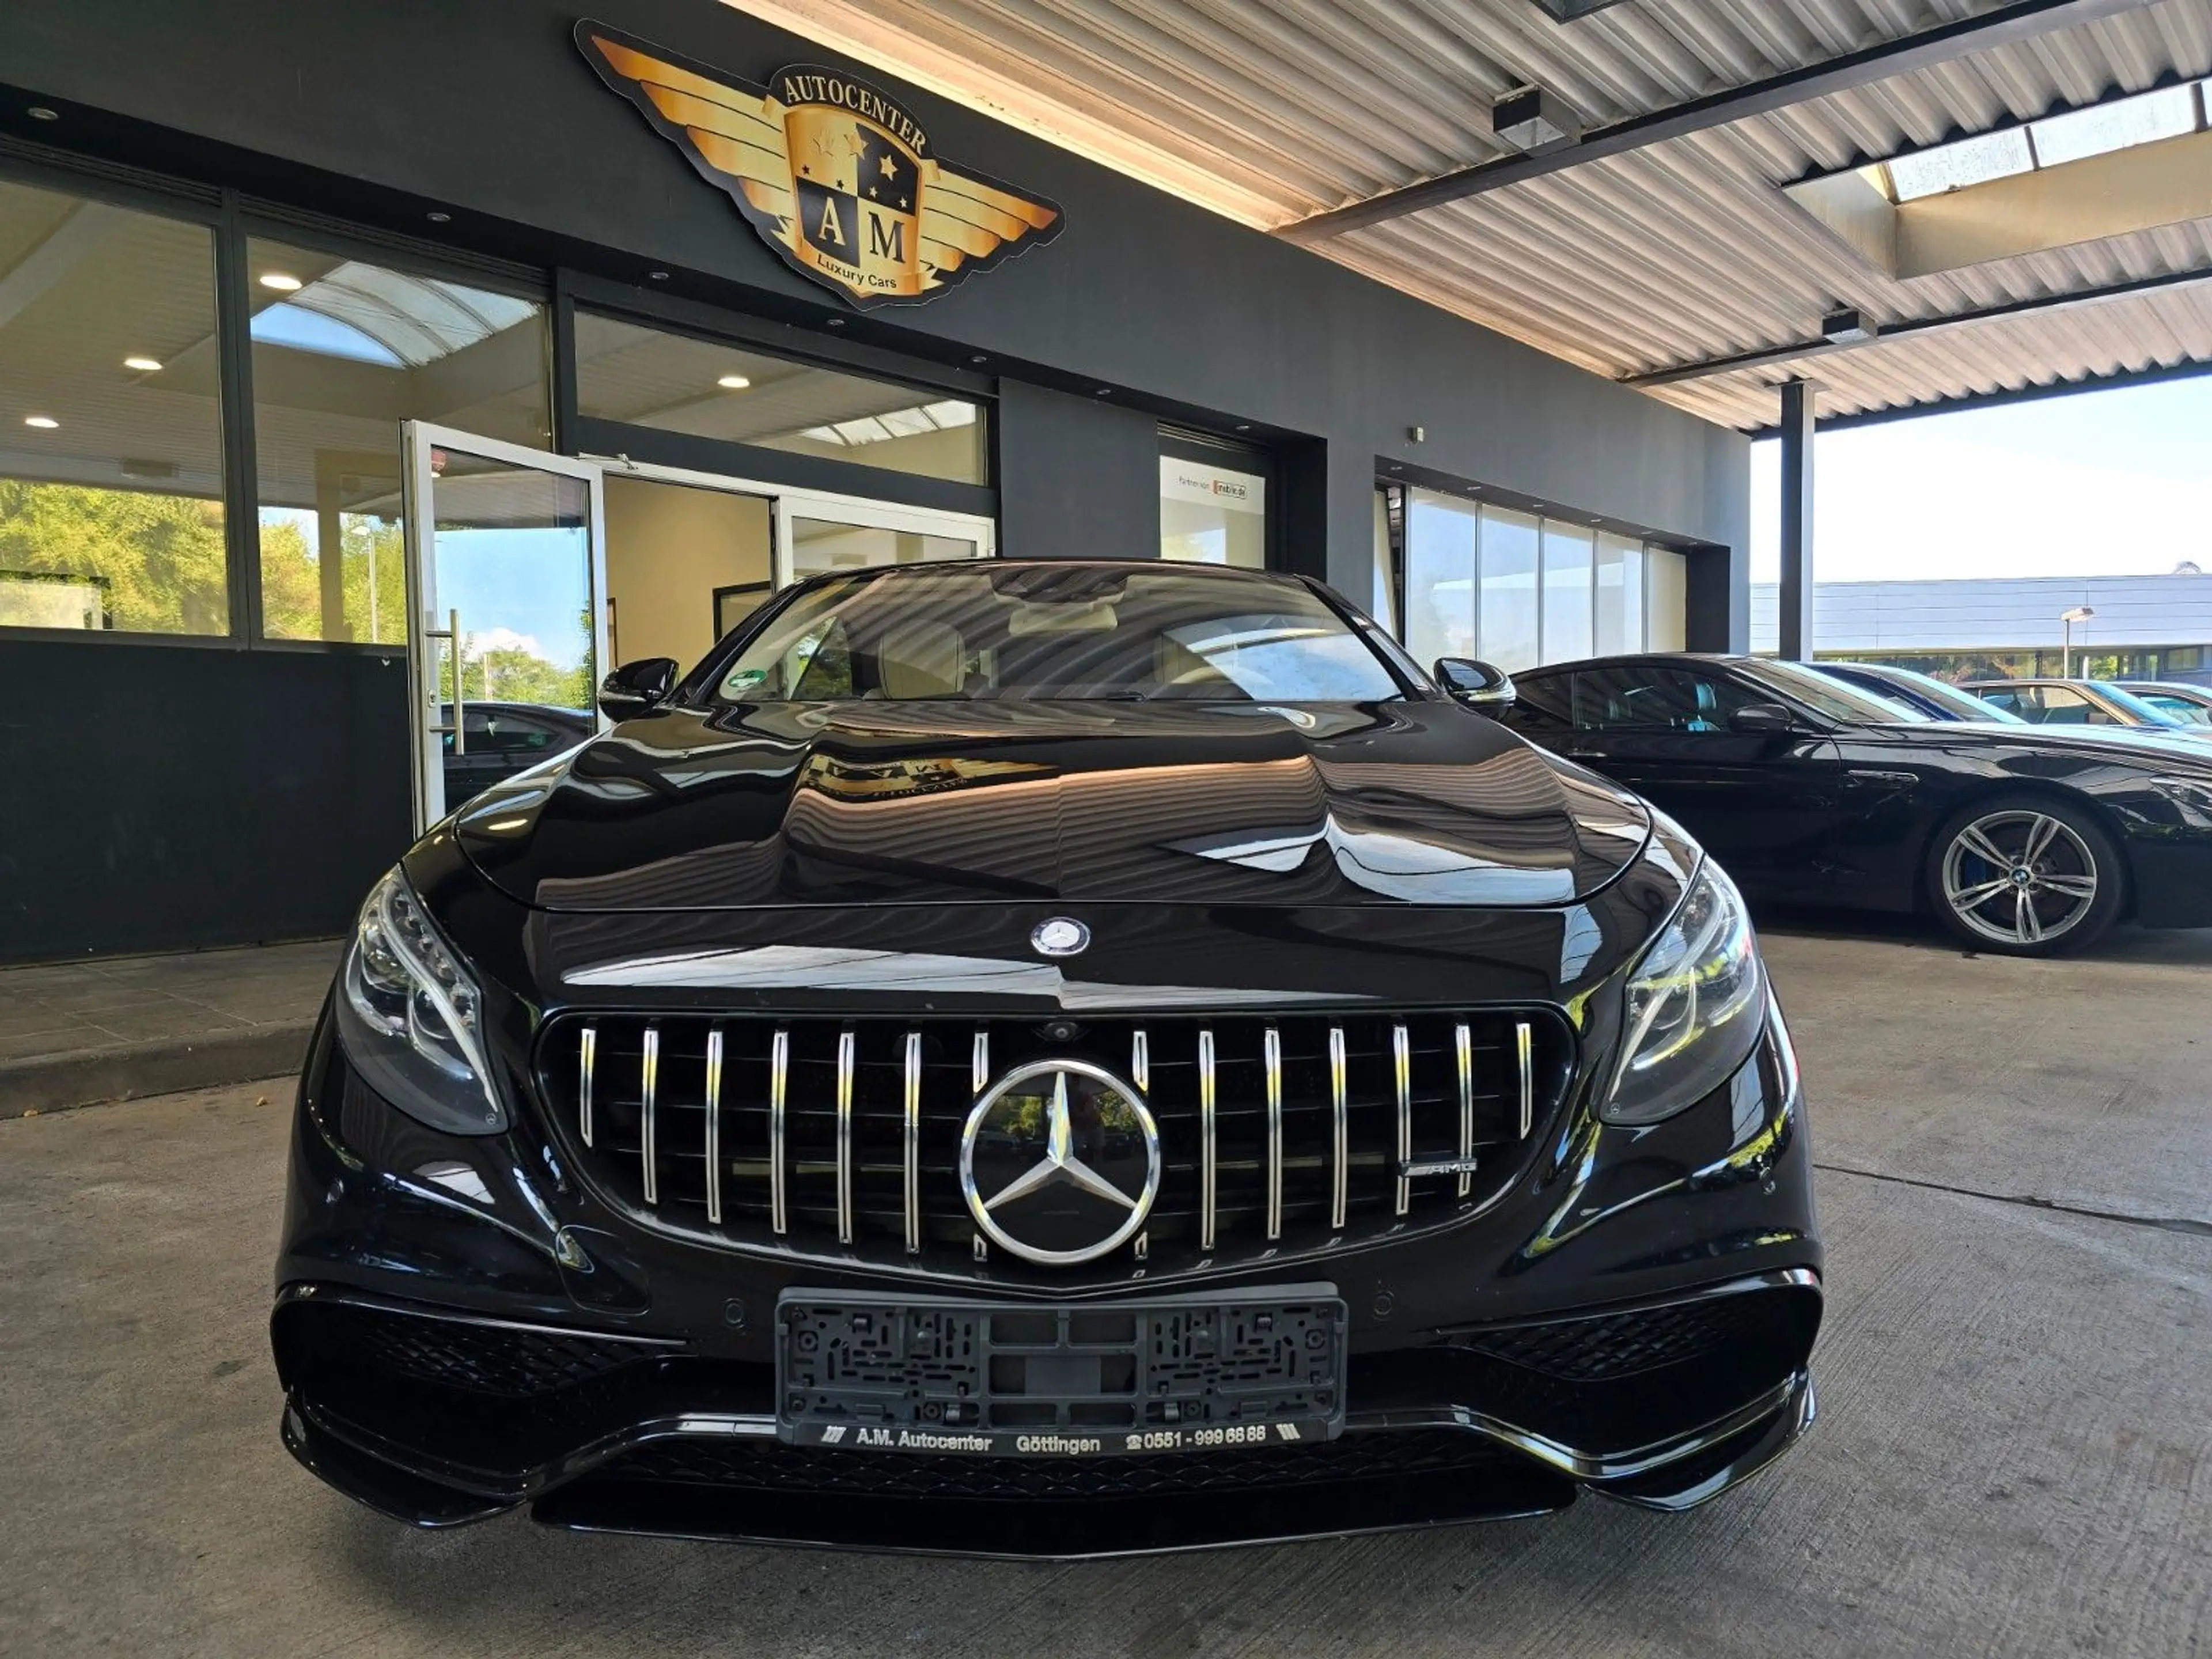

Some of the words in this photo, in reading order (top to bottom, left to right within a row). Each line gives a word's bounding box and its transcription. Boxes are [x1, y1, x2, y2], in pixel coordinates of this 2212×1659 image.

[784, 75, 927, 156] AUTOCENTER
[819, 196, 846, 246] A
[868, 211, 906, 264] M
[817, 254, 864, 285] Luxury
[868, 274, 897, 289] Cars
[856, 1428, 894, 1446] A.M.
[898, 1430, 993, 1451] Autocenter
[1016, 1435, 1101, 1455] Göttingen
[1143, 1431, 1181, 1449] 0551
